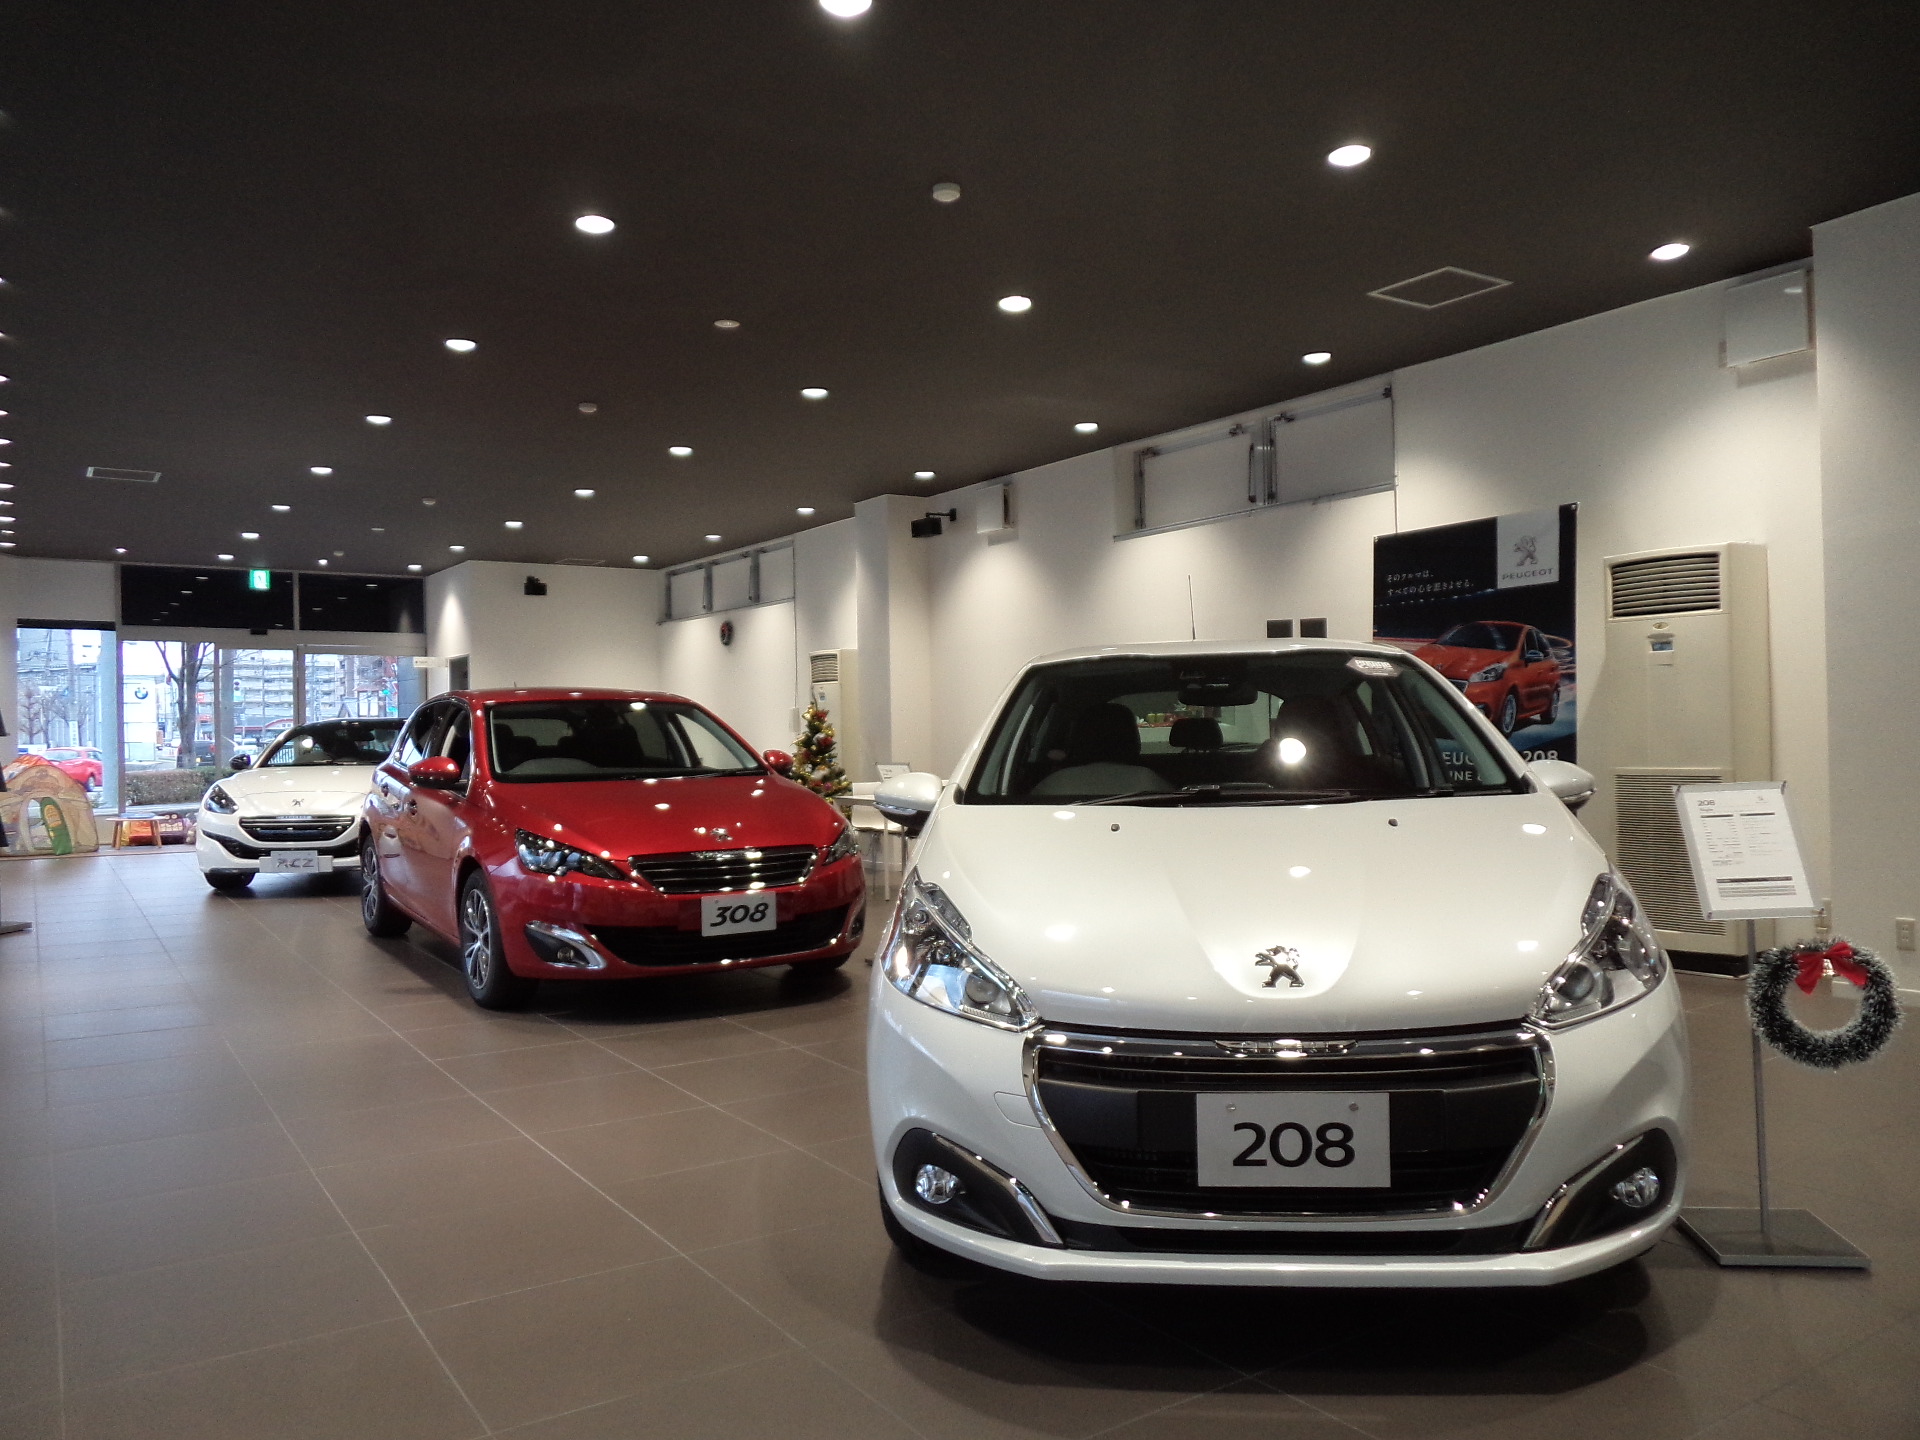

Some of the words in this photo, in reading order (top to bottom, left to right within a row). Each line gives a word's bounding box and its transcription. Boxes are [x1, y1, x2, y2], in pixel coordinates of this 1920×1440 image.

[1502, 567, 1554, 580] PEUGEOT
[1697, 799, 1716, 807] 208
[710, 902, 769, 928] 308
[1232, 1121, 1356, 1168] 208
